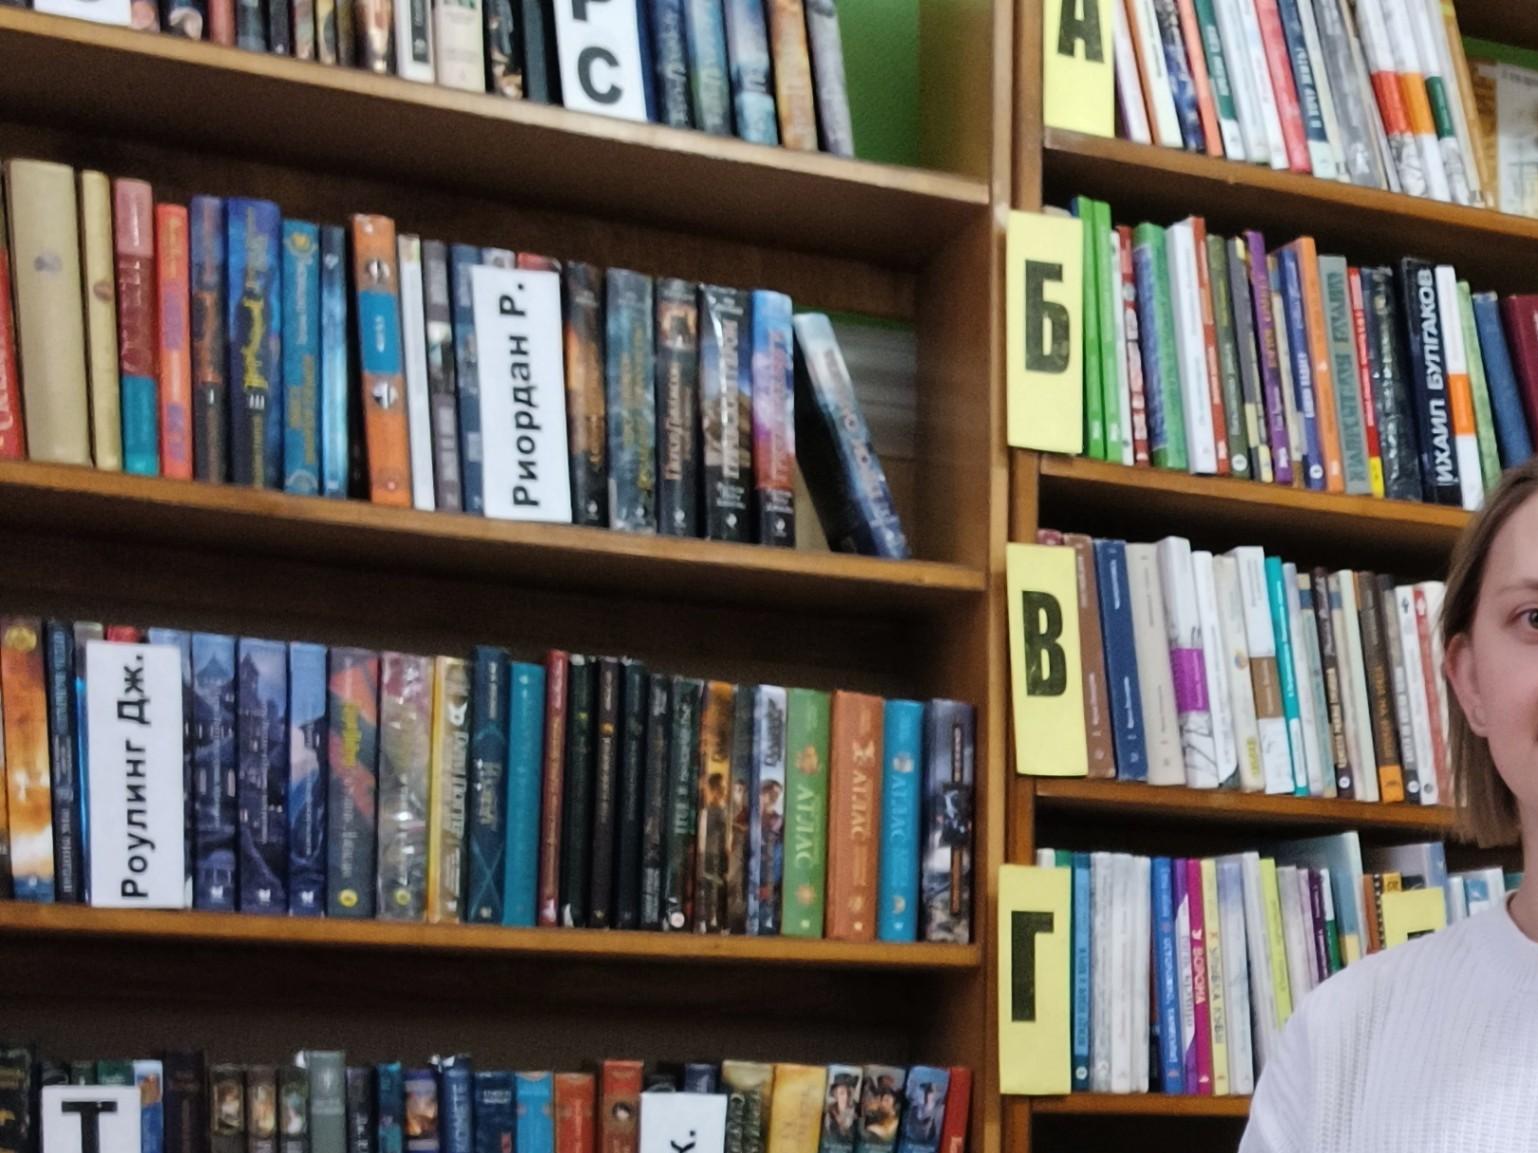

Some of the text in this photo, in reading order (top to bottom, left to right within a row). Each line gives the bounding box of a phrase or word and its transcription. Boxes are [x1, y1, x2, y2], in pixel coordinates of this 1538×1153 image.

[577, 46, 622, 104] С
[1025, 259, 1070, 374] Б
[498, 281, 541, 509] Риордан Р.
[1418, 269, 1456, 487] ИХАИЛ БУЛГАКОВ
[1022, 590, 1066, 697] В
[116, 652, 152, 901] Роулинг Дж.
[794, 783, 814, 869] АТЛАС
[1011, 910, 1054, 1022] Г
